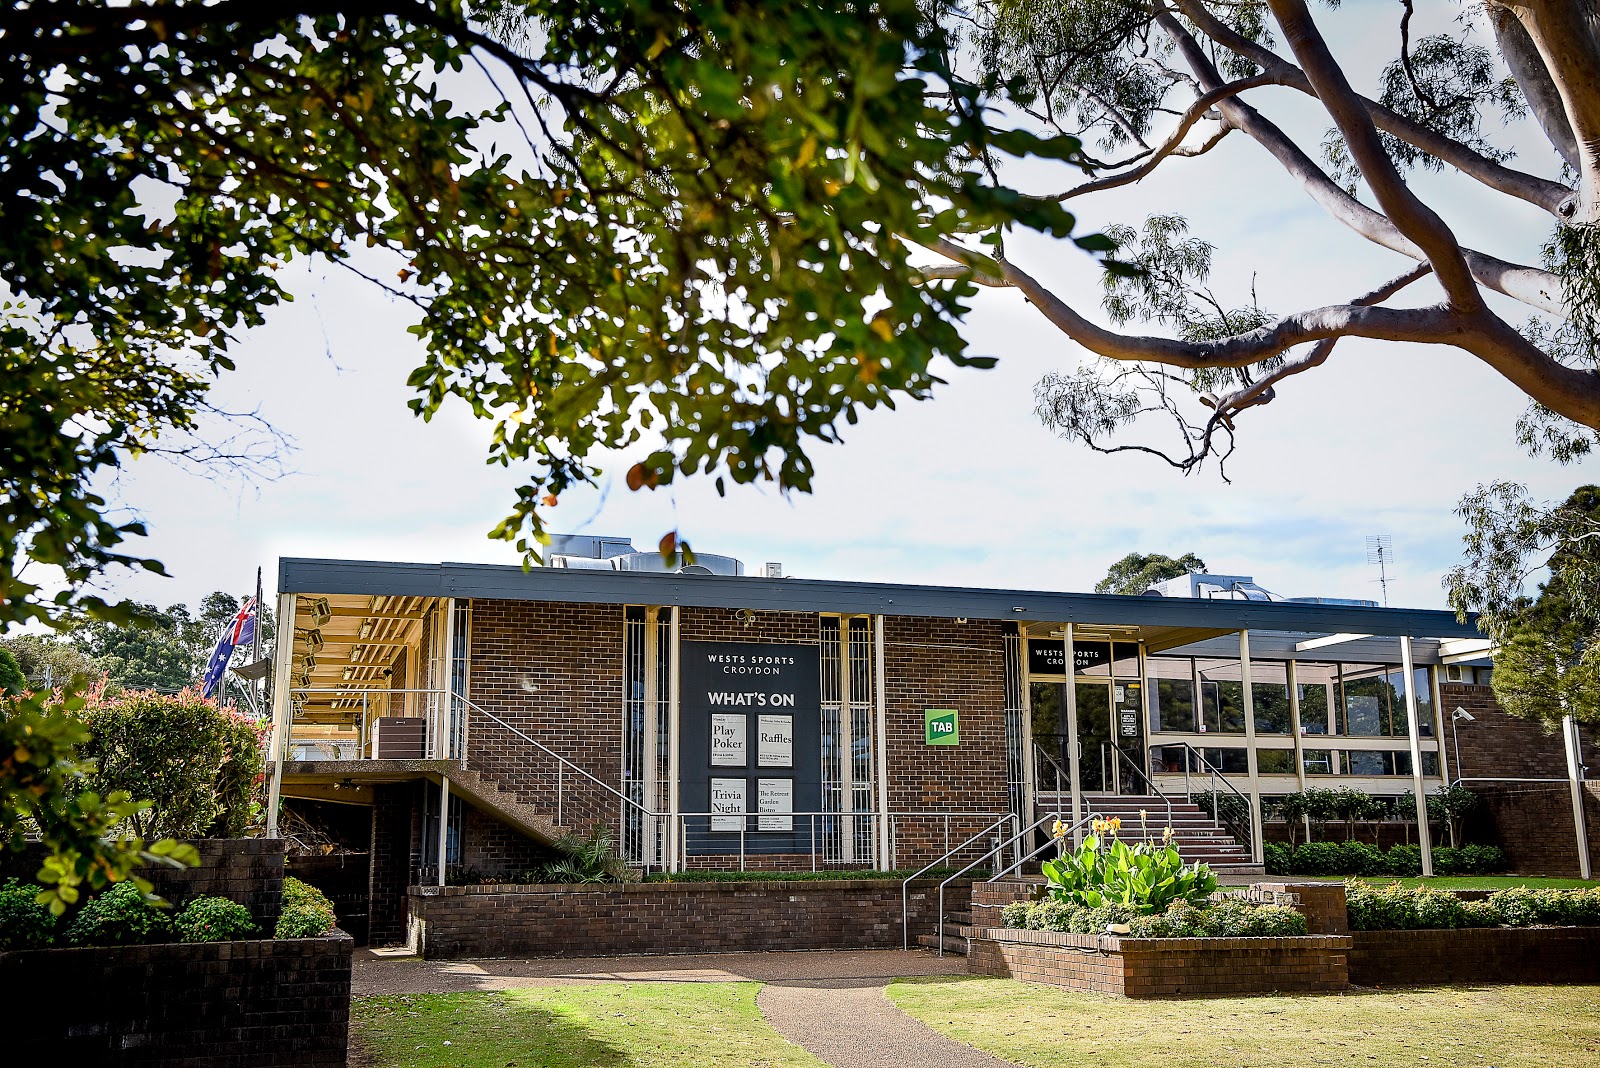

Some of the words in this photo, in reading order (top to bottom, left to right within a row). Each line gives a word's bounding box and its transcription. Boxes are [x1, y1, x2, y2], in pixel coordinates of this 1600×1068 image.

[1035, 649, 1063, 657] WESTS
[1072, 650, 1099, 658] PORTS
[708, 654, 745, 664] WESTS
[751, 656, 795, 665] SPORTS
[1046, 658, 1089, 666] CROON
[723, 665, 780, 675] CROYDON
[708, 691, 767, 706] WHAT'S
[769, 693, 795, 707] ON
[713, 724, 736, 739] Play
[931, 722, 953, 732] TAB
[713, 737, 743, 749] Poker
[760, 732, 792, 744] Raffles
[712, 789, 742, 800] Trivia
[712, 802, 741, 814] Night
